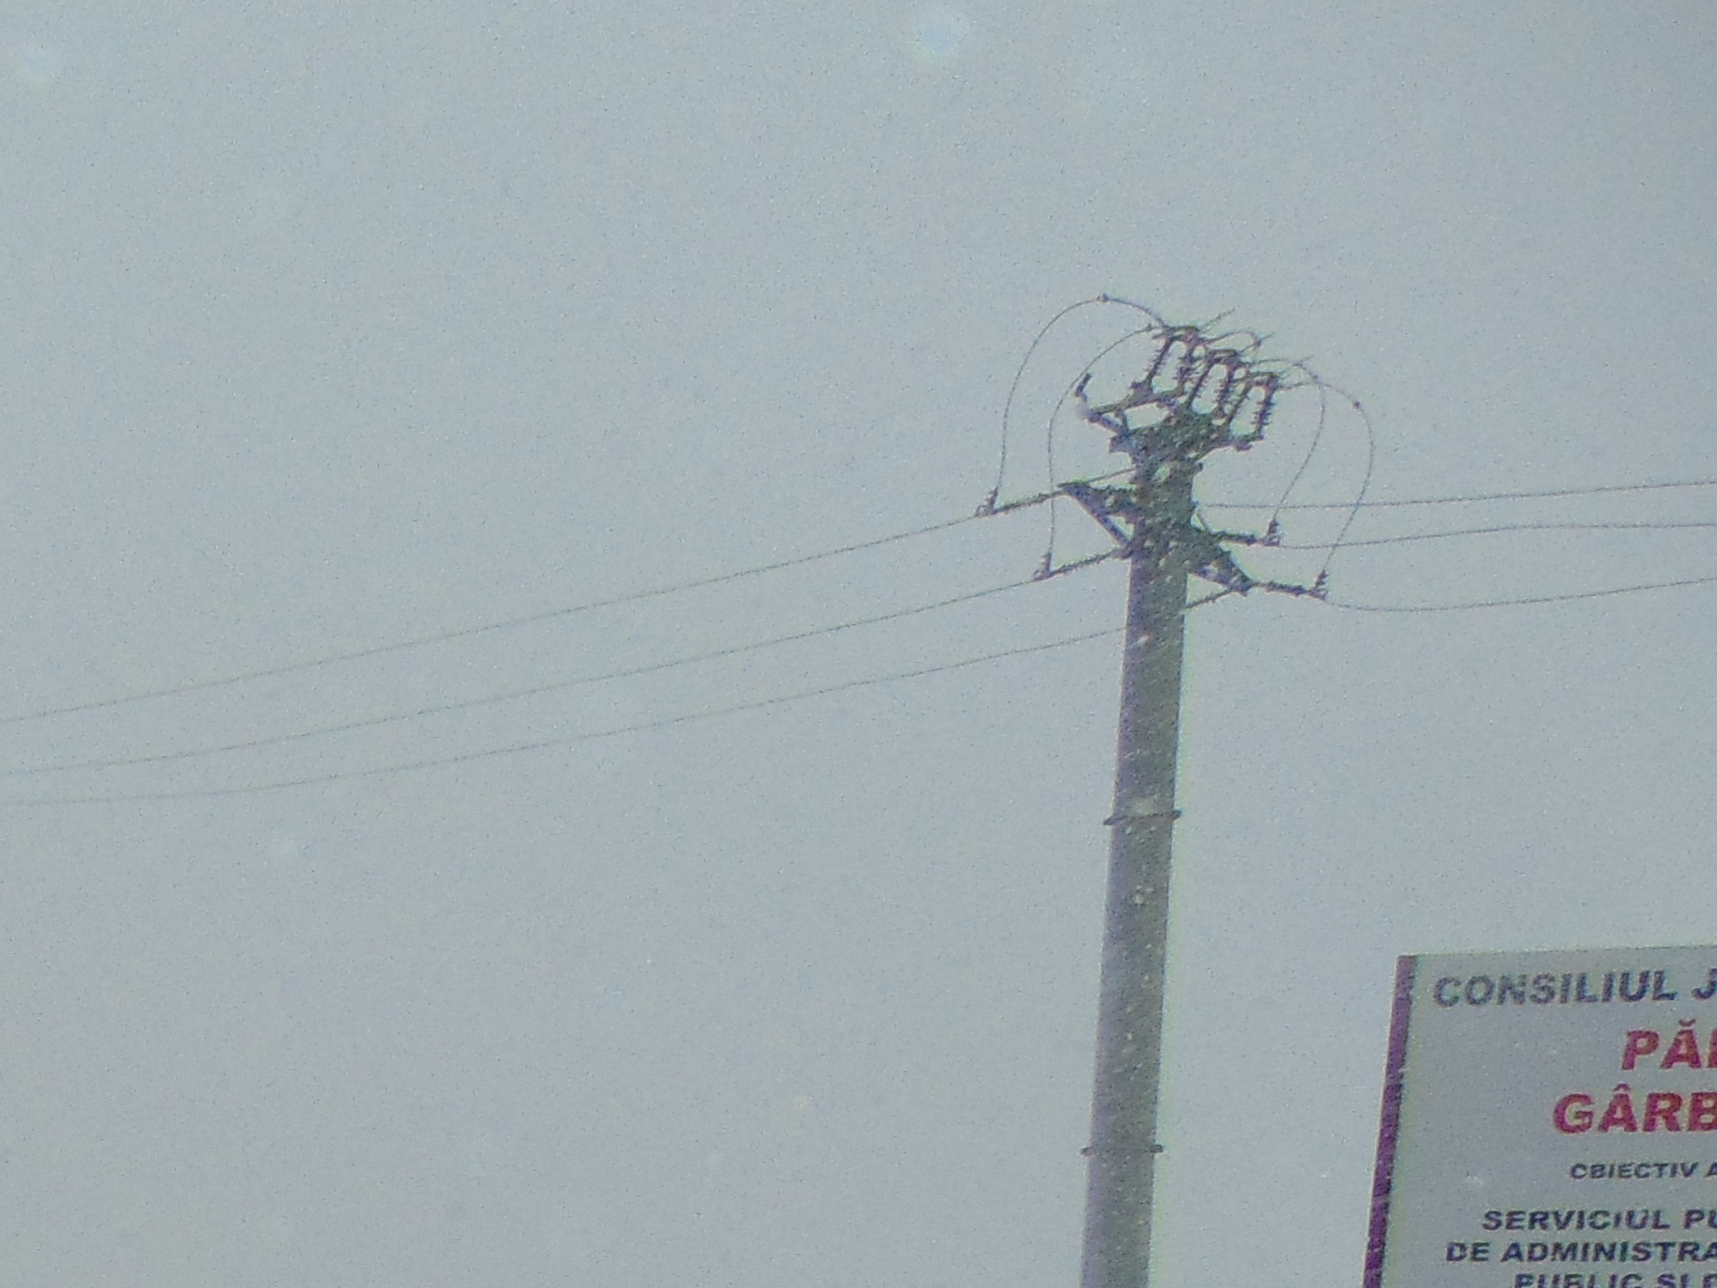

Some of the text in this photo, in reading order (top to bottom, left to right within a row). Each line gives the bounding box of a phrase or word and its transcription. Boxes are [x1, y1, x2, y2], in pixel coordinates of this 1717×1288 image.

[1433, 969, 1677, 1007] CONSILIUL
[1621, 1018, 1717, 1071] PĂ
[1553, 1083, 1717, 1134] GÂRB
[1482, 1209, 1671, 1231] SERVICIUL
[1445, 1242, 1491, 1262] DE
